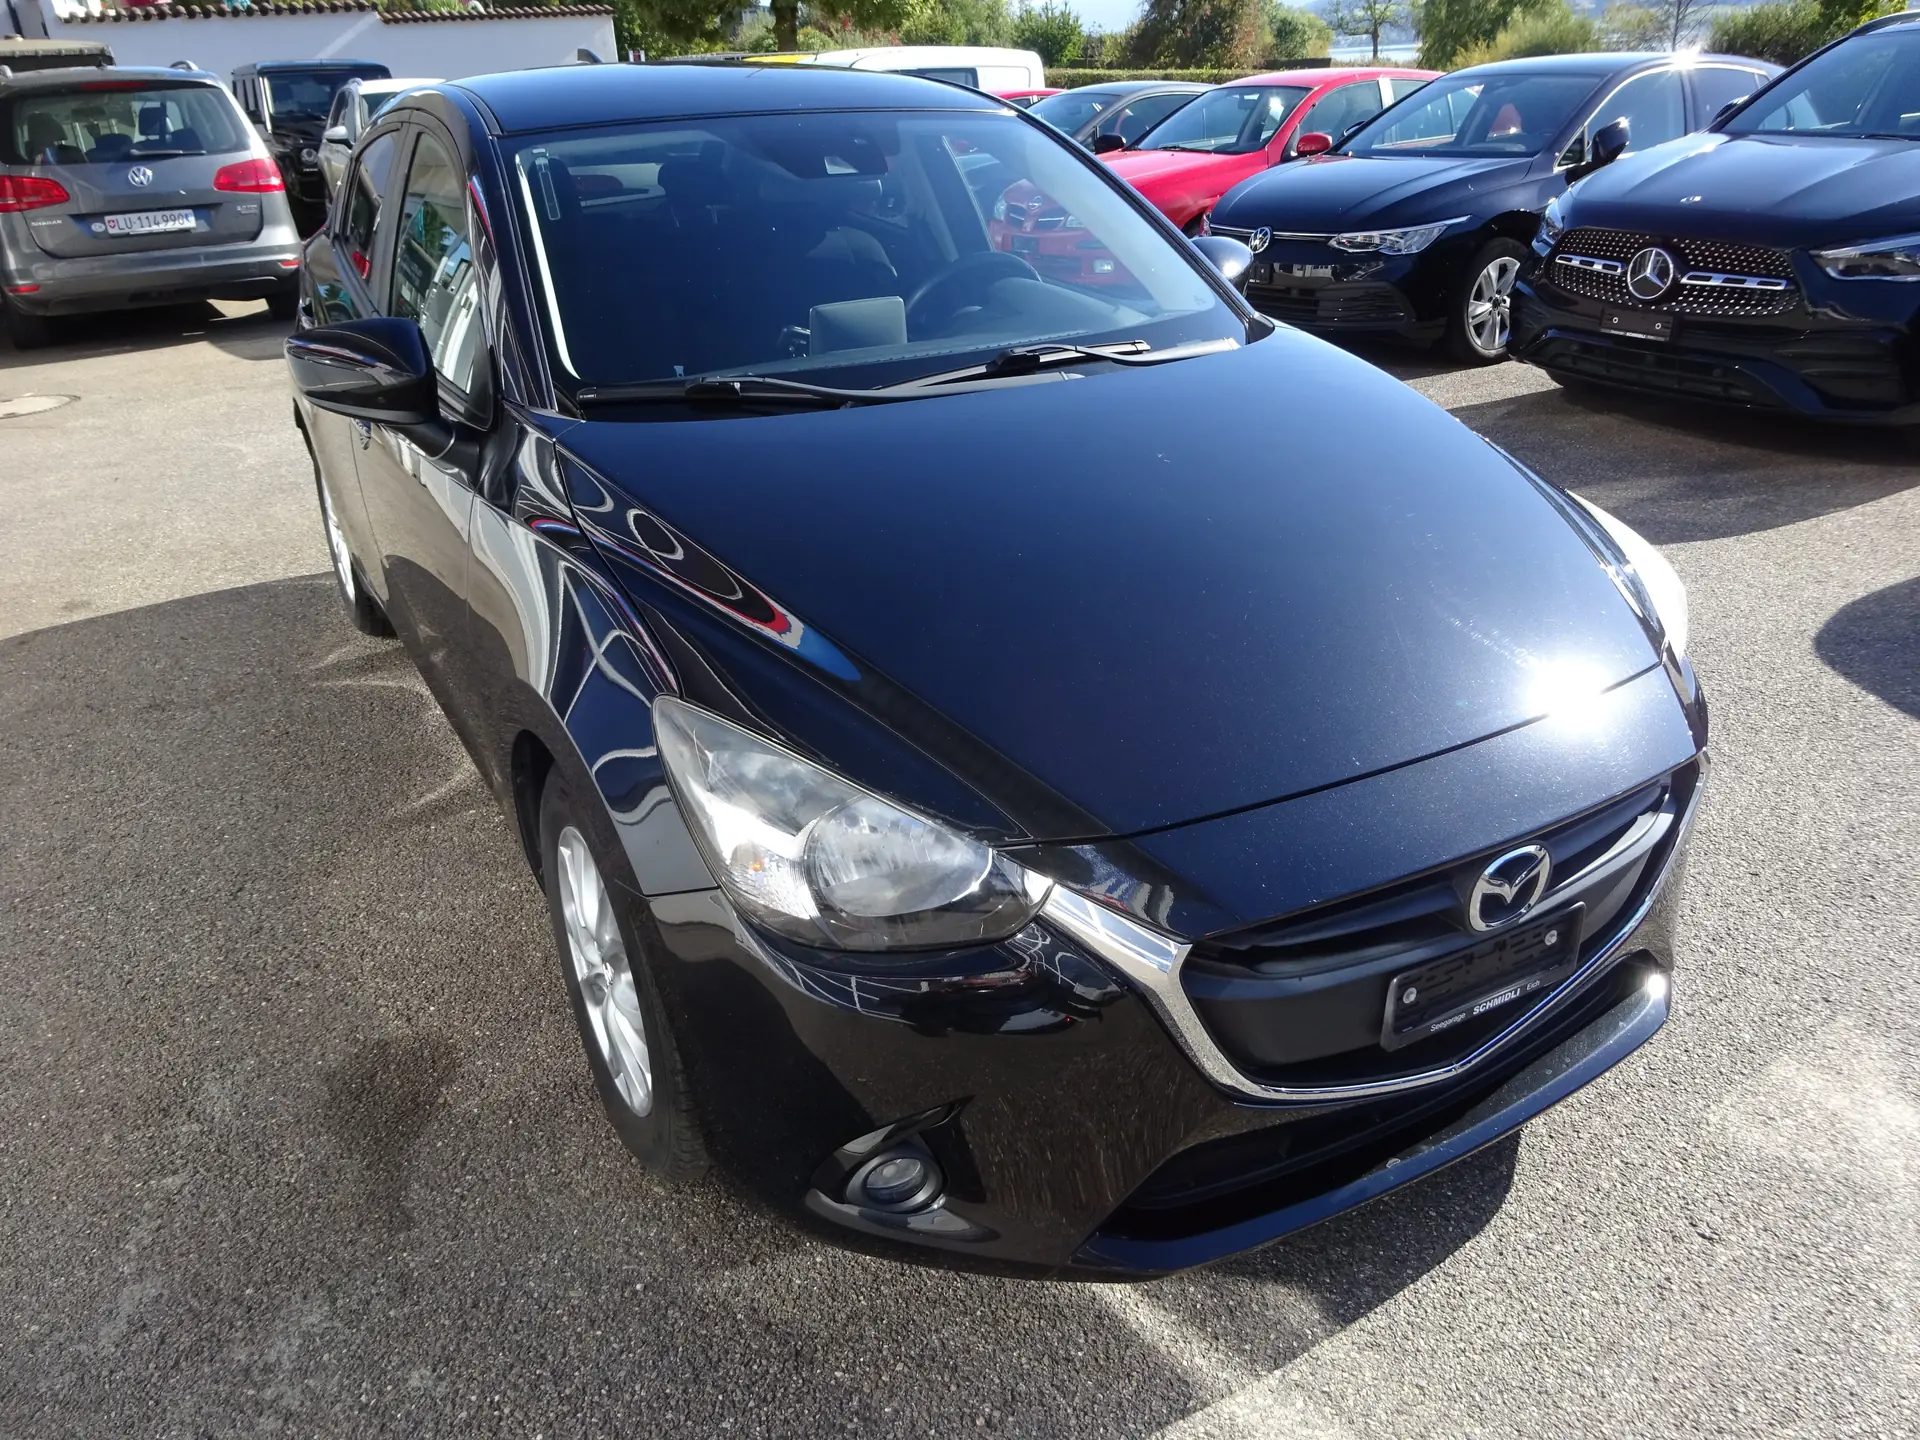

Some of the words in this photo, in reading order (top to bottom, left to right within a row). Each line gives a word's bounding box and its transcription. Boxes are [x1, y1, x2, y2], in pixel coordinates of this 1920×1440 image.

[1430, 1012, 1466, 1032] Seegarage
[1472, 988, 1521, 1015] SCHMIDLI
[1526, 980, 1541, 990] Eich
